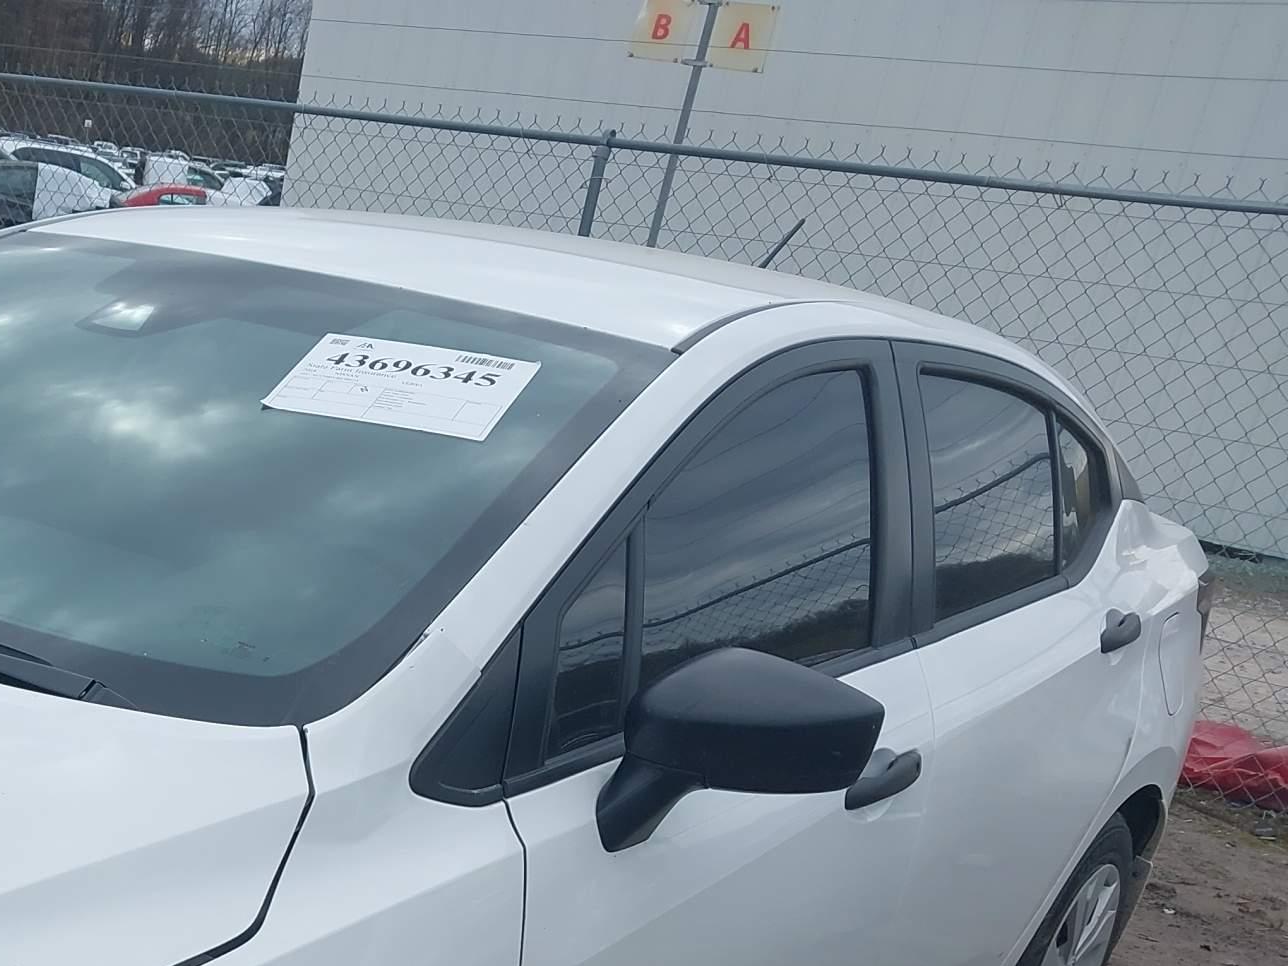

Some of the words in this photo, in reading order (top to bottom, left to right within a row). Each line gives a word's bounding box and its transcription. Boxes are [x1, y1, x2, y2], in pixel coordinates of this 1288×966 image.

[651, 14, 672, 40] B
[730, 22, 751, 50] A
[326, 352, 502, 388] 43696345
